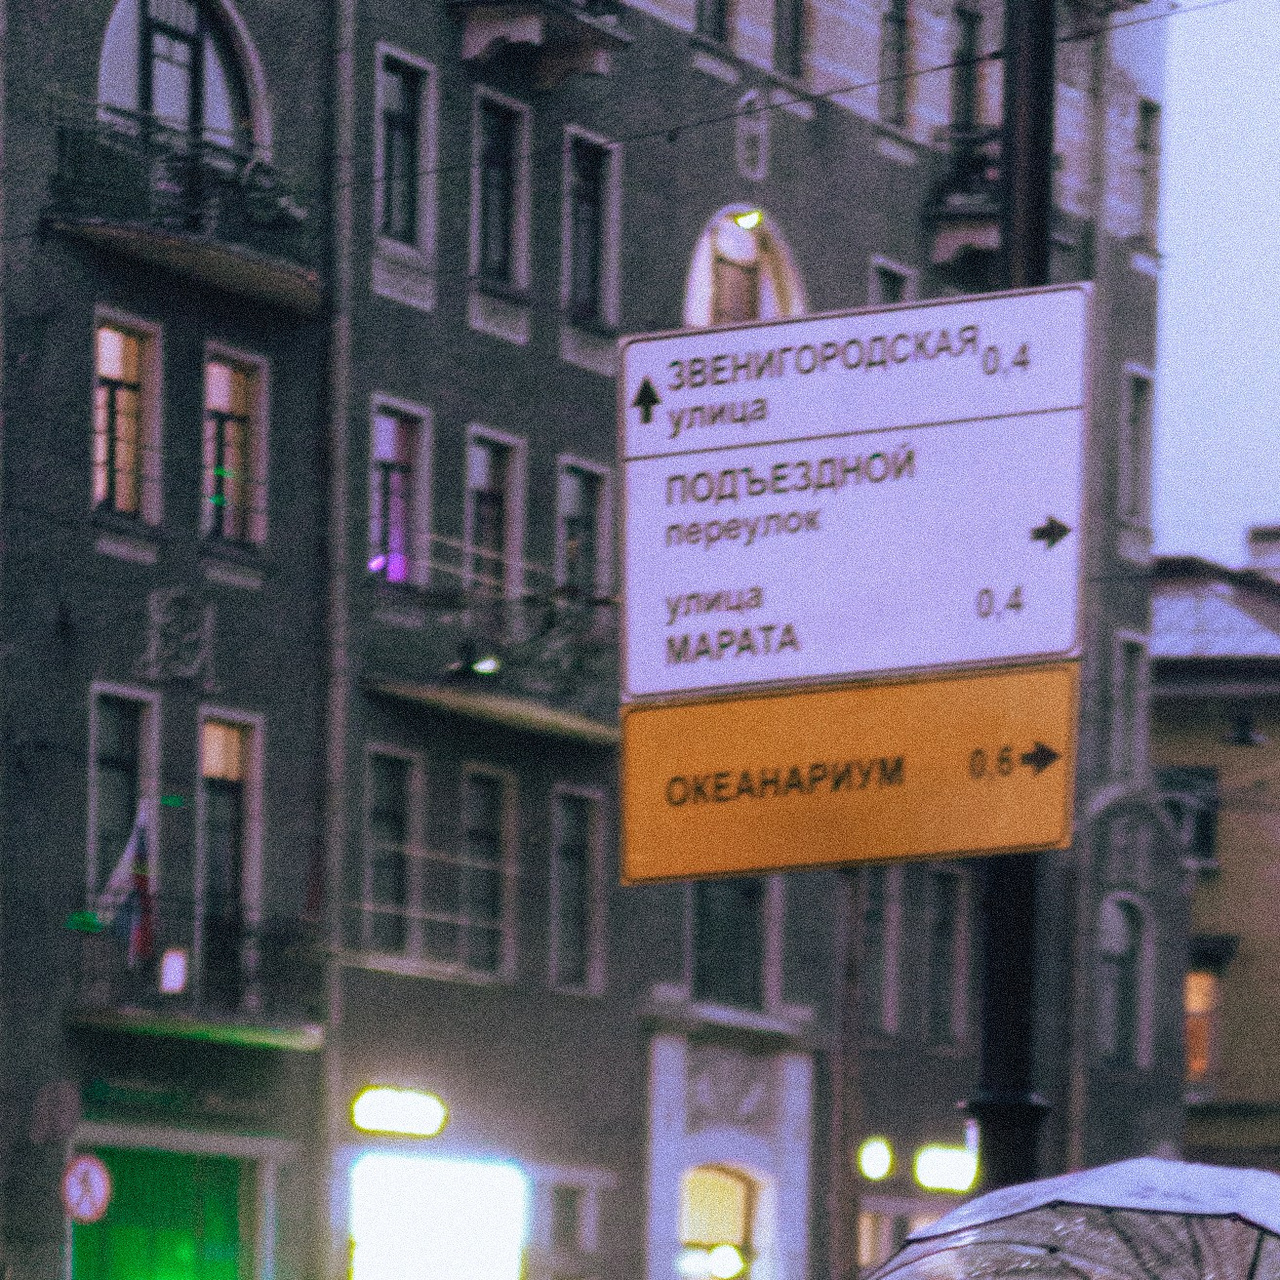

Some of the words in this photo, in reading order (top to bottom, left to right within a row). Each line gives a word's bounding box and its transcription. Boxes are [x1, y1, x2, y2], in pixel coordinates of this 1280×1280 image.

[667, 325, 979, 390] ЗВЕНИГОРОДСКАЯ
[667, 398, 767, 438] улица
[665, 443, 915, 504] ПОДЪЕЗДНОЙ
[665, 510, 820, 549] переулок
[665, 586, 763, 625] улица
[665, 624, 801, 663] МАРАТА
[665, 756, 905, 806] ОКЕАНАРИУМ
